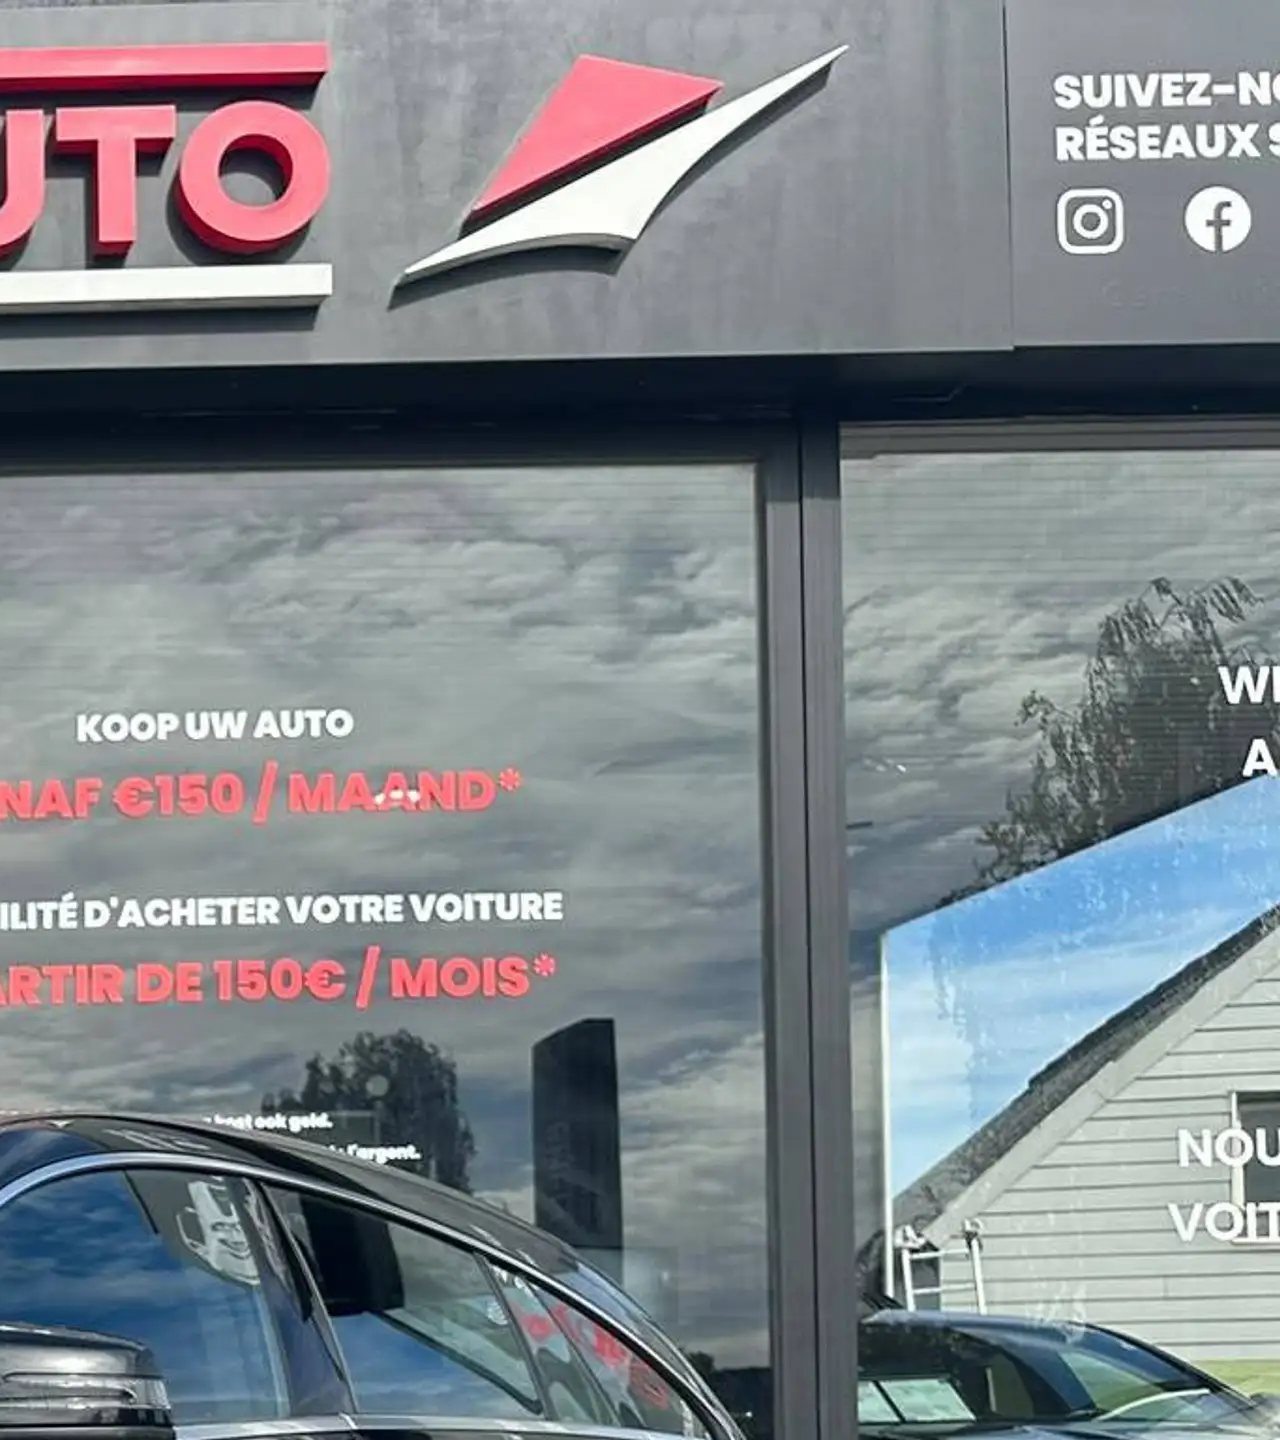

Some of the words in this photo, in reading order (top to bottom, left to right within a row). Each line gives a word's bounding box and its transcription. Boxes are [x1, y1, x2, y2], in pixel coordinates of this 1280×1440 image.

[1053, 71, 1280, 110] SUIVEZ-N
[1054, 114, 1261, 161] RÉSEAUX
[76, 711, 181, 743] KOOP
[184, 710, 248, 741] UW
[251, 708, 355, 740] AUTO
[112, 771, 243, 819] €150
[83, 895, 281, 929] D'ACHETER
[284, 893, 405, 925] VOTRE
[409, 891, 564, 923] VOITURE
[134, 960, 203, 1004] DE
[213, 958, 346, 1002] 150€
